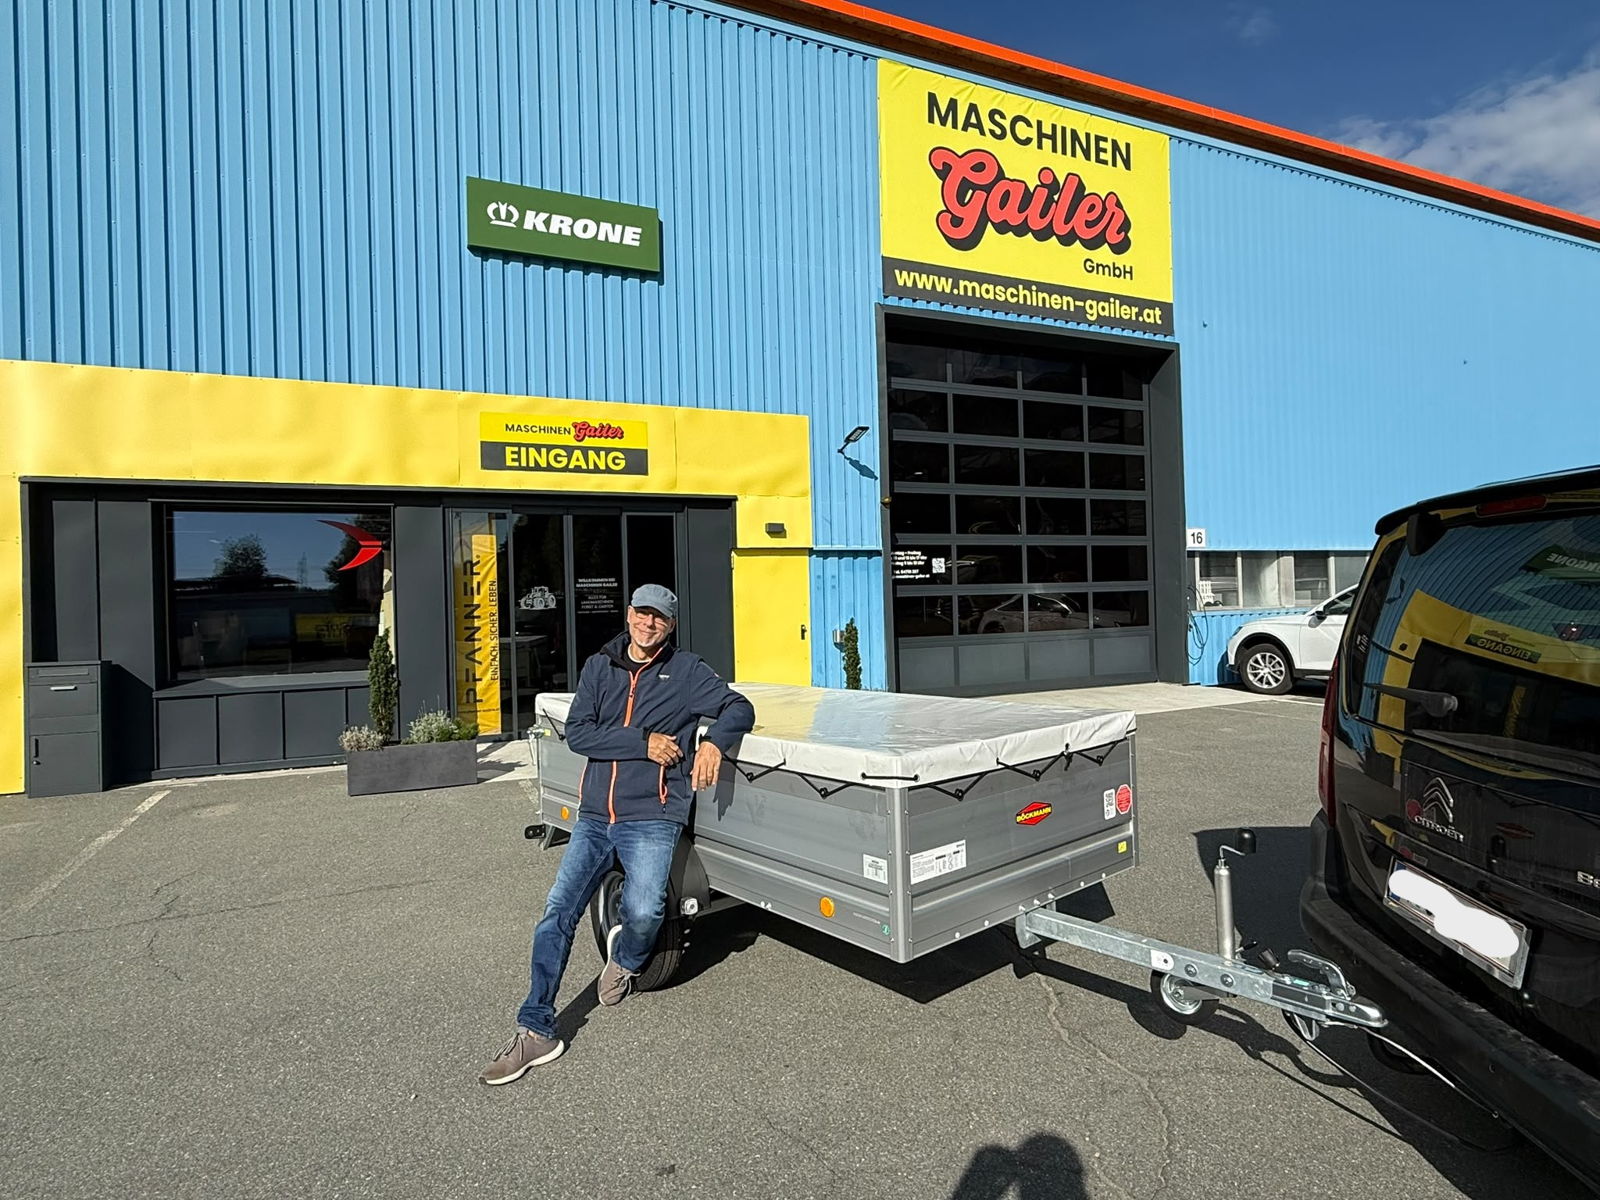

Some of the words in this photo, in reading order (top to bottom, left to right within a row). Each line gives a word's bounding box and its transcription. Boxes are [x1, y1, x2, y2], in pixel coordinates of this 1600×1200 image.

[927, 91, 1131, 171] MASCHINEN
[929, 146, 1132, 255] Gailer
[523, 210, 642, 246] KRONE
[1083, 258, 1133, 280] GmbH
[895, 268, 1162, 325] www.maschinen-gailer.at
[505, 423, 571, 435] MASCHINEN
[571, 421, 624, 442] Gailer
[505, 446, 626, 470] EINGANG
[1191, 532, 1203, 544] 16
[490, 644, 499, 680] EINFACH.
